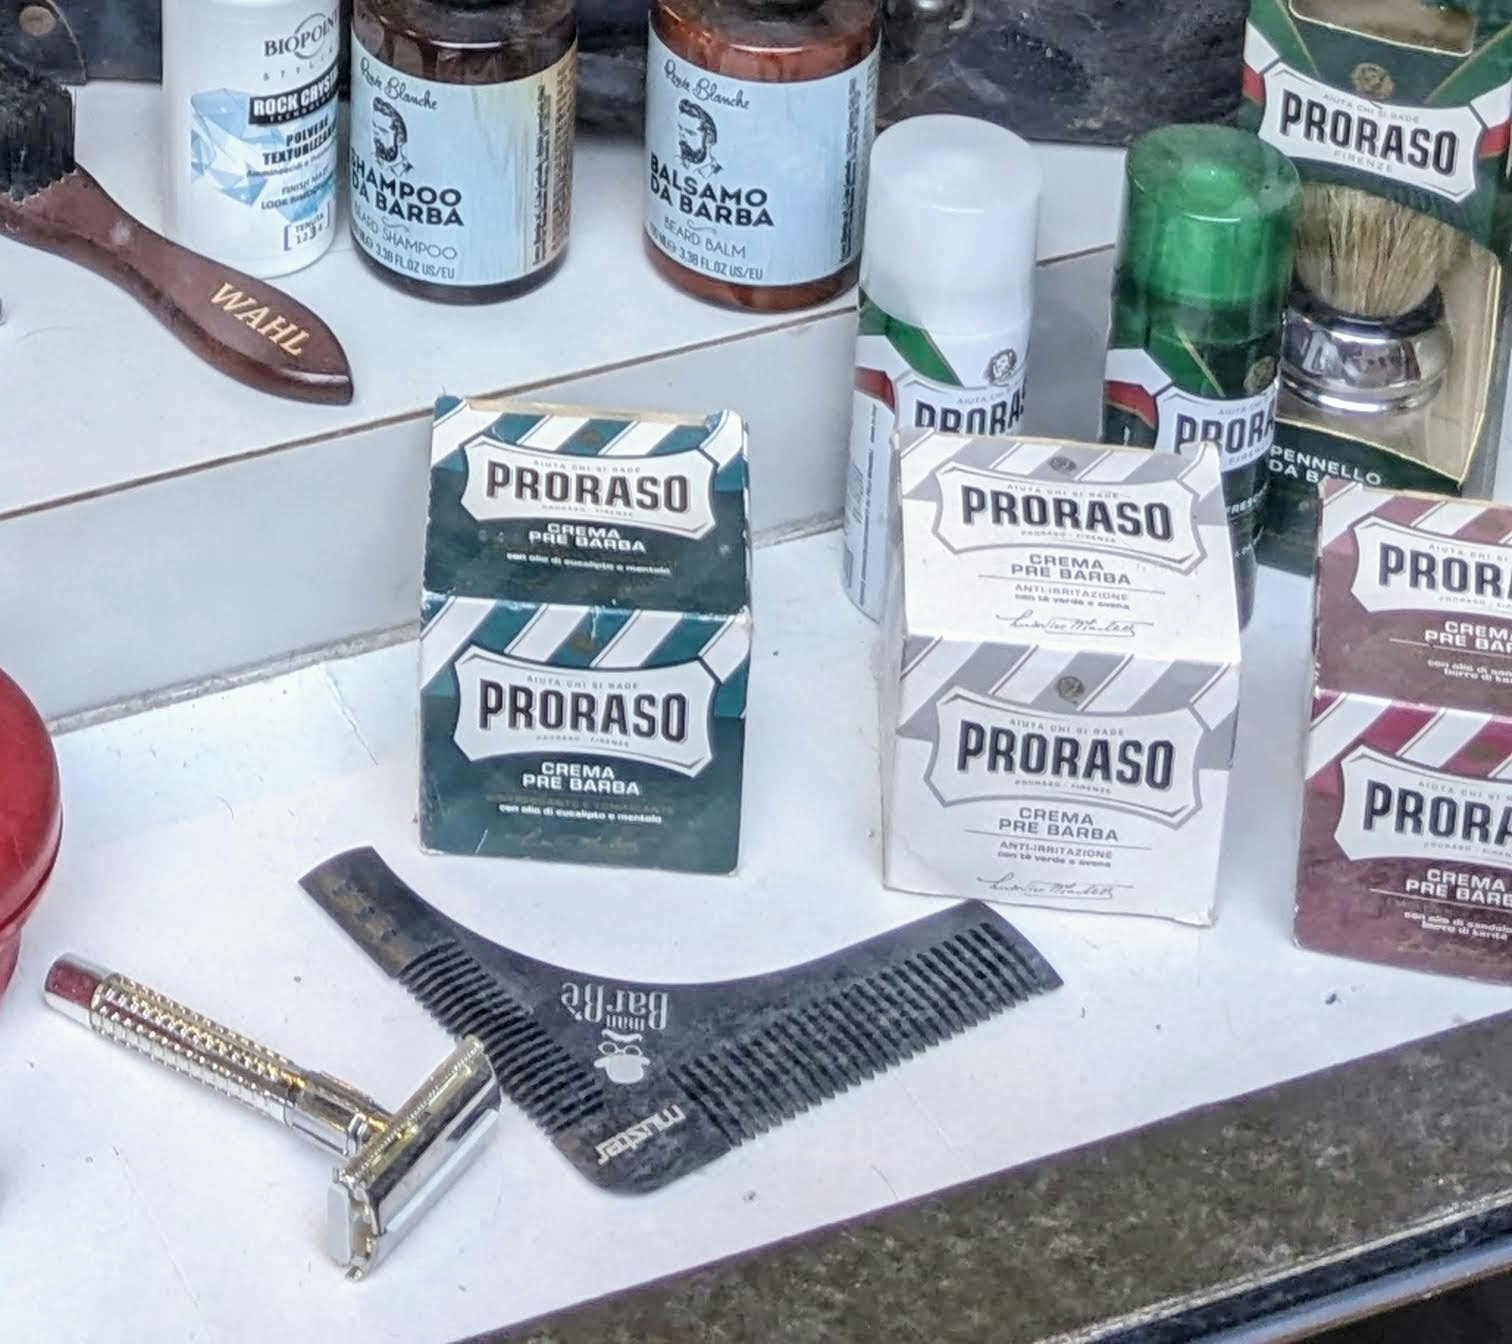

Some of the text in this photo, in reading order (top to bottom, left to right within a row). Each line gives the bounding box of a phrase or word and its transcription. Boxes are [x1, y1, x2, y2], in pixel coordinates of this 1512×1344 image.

[253, 92, 299, 116] ROCK
[385, 76, 438, 110] Blanche
[693, 77, 750, 110] Blanche
[1279, 88, 1459, 177] PRORASO
[650, 151, 768, 207] BALSAMO
[376, 194, 465, 227] BARBA
[650, 175, 774, 227] DA BARBA
[382, 229, 458, 260] SHAMPOO
[664, 216, 700, 246] BEARD
[705, 240, 746, 259] BALM
[422, 261, 455, 279] US/EU
[729, 263, 763, 280] US/EU
[210, 282, 309, 356] WAHL
[1268, 444, 1382, 486] PENNELLO
[1268, 462, 1299, 478] DA
[486, 459, 689, 513] PRORASO
[961, 484, 1173, 543] PRORASO
[529, 530, 647, 553] PRE BARBA
[547, 522, 621, 540] CREMA
[1029, 553, 1104, 570] CREMA
[1379, 542, 1512, 600] PROR
[1011, 564, 1131, 585] PRE BARBA
[1425, 630, 1466, 647] PRE
[479, 678, 687, 744] PRORASO
[956, 719, 1175, 792] PRORASO
[541, 762, 615, 780] CREMA
[522, 774, 640, 796] PRE BARBA
[499, 803, 519, 814] con
[521, 804, 541, 815] olio
[556, 808, 605, 822] eucalipto
[1019, 807, 1094, 826] CREMA
[1363, 778, 1512, 845] PRORA
[998, 818, 1119, 842] PRE BARBA
[997, 851, 1111, 868] con verde avena
[1000, 840, 1113, 859] ANTI-IRRITAZIONE
[1406, 879, 1450, 897] PRE
[1427, 868, 1506, 892] CREMA
[595, 1104, 686, 1165] muster
